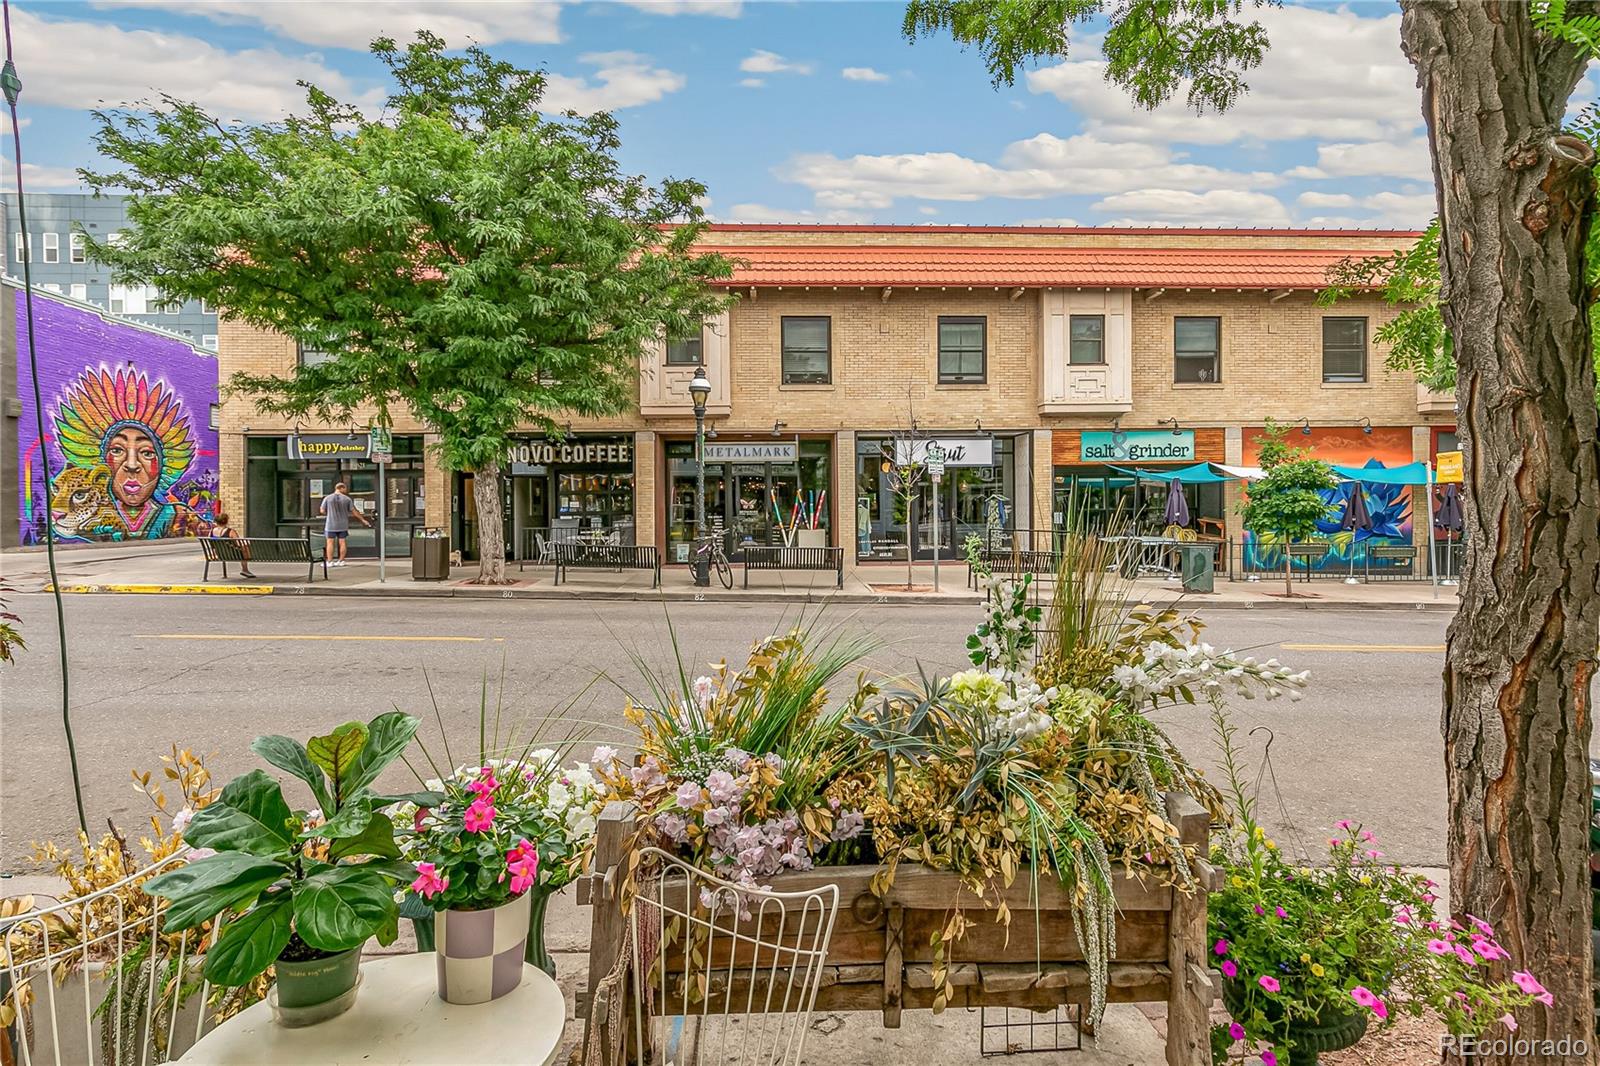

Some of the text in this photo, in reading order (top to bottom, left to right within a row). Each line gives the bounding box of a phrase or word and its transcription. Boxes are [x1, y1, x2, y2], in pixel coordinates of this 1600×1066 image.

[299, 441, 340, 454] happy
[1085, 431, 1189, 461] salt & grinder
[507, 445, 628, 463] NOVO COFFEE
[704, 447, 791, 457] METALMARK
[502, 590, 513, 598] 80
[694, 593, 705, 601] 82
